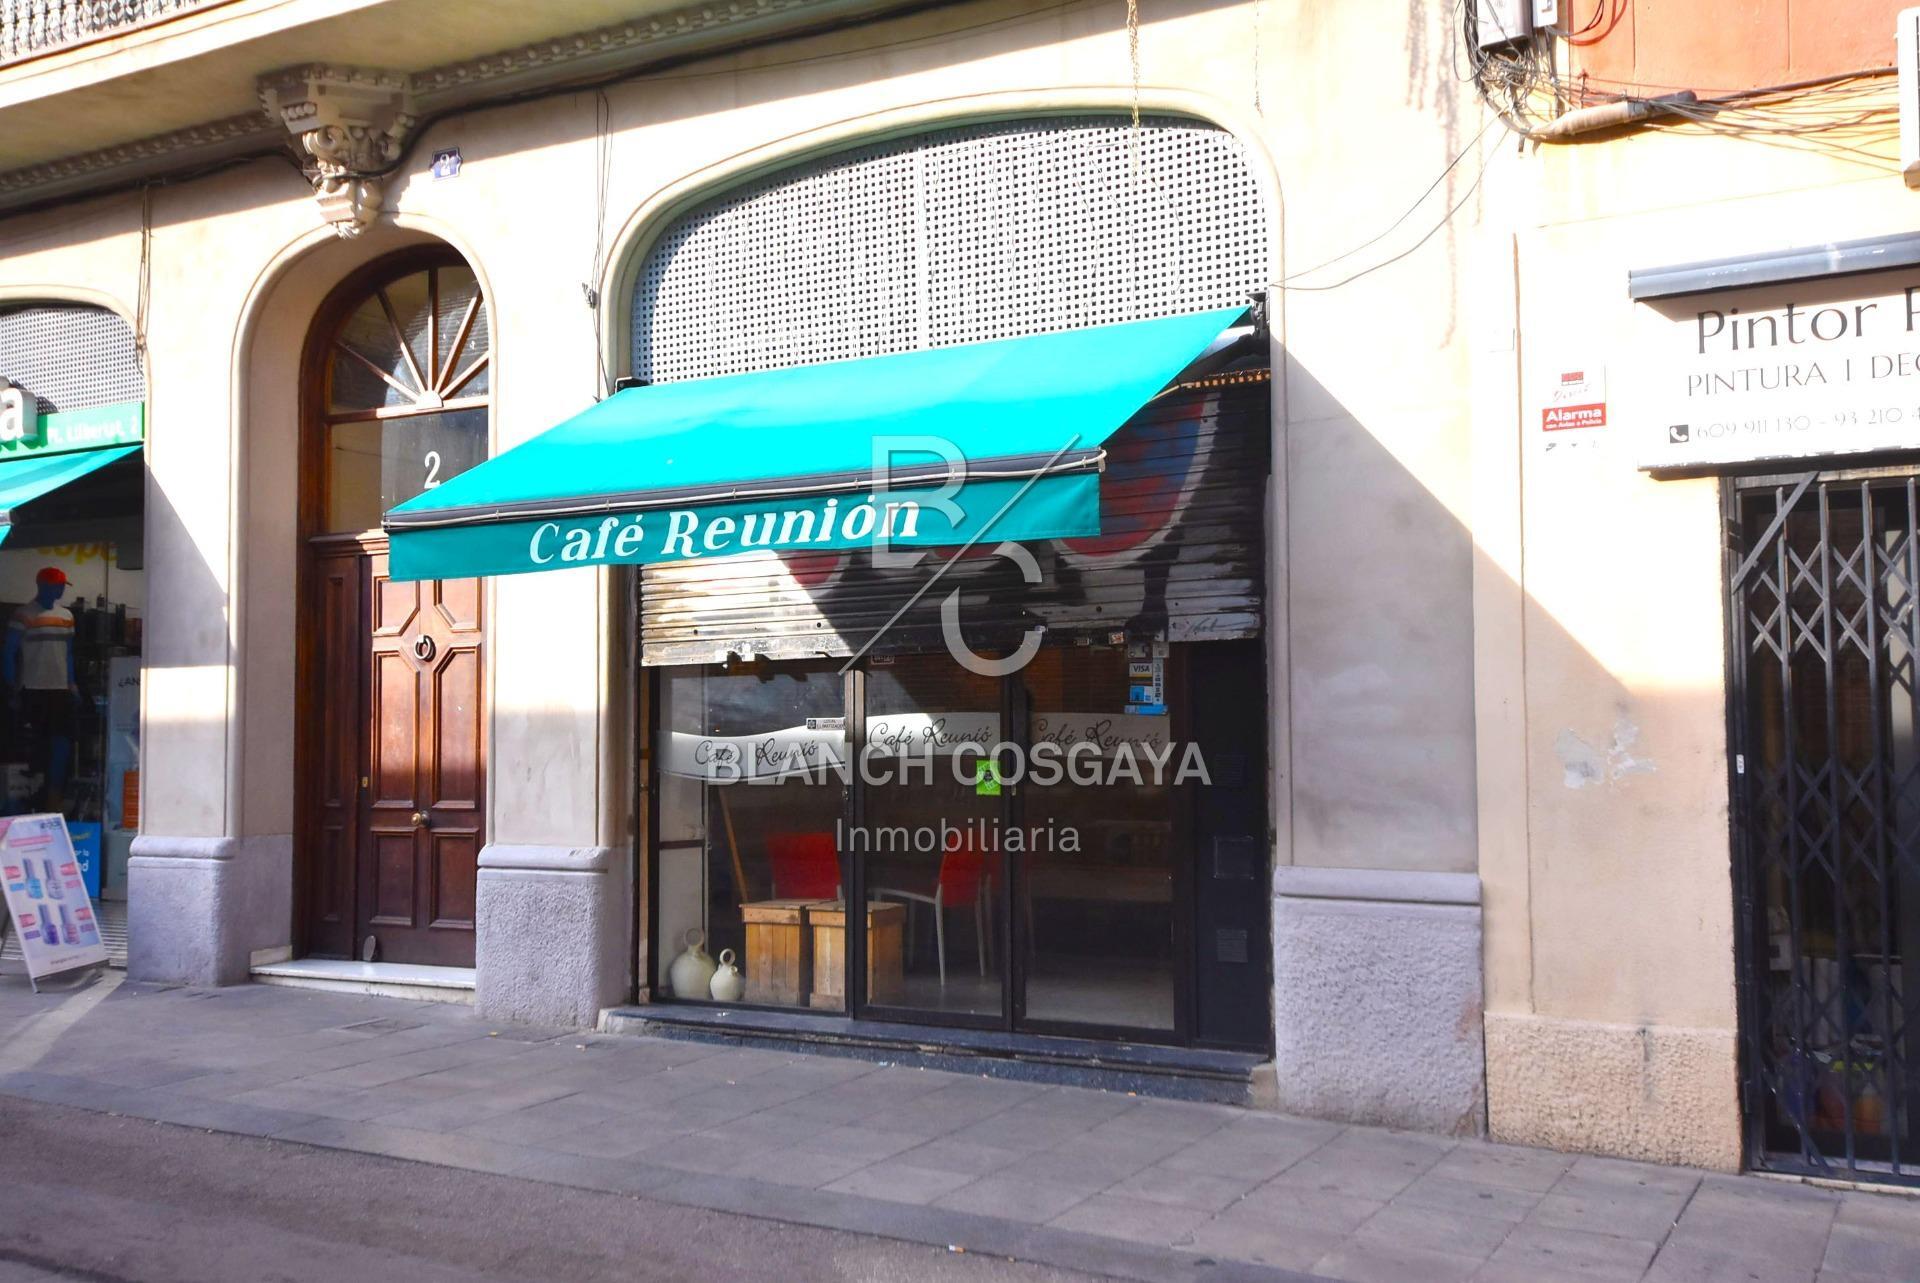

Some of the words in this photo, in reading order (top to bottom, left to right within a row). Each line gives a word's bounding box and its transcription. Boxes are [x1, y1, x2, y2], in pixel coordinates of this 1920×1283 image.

[1697, 303, 1877, 354] Pintor
[1688, 361, 1827, 396] PINTURA
[1846, 358, 1851, 381] I
[1871, 353, 1920, 379] DE
[1546, 409, 1602, 422] Alarma
[424, 451, 441, 489] 2
[529, 513, 643, 564] Café
[660, 493, 920, 558] Reunión
[1133, 664, 1150, 673] VISA
[869, 722, 914, 753] Café
[922, 717, 992, 748] Reunió
[695, 739, 736, 769] Café
